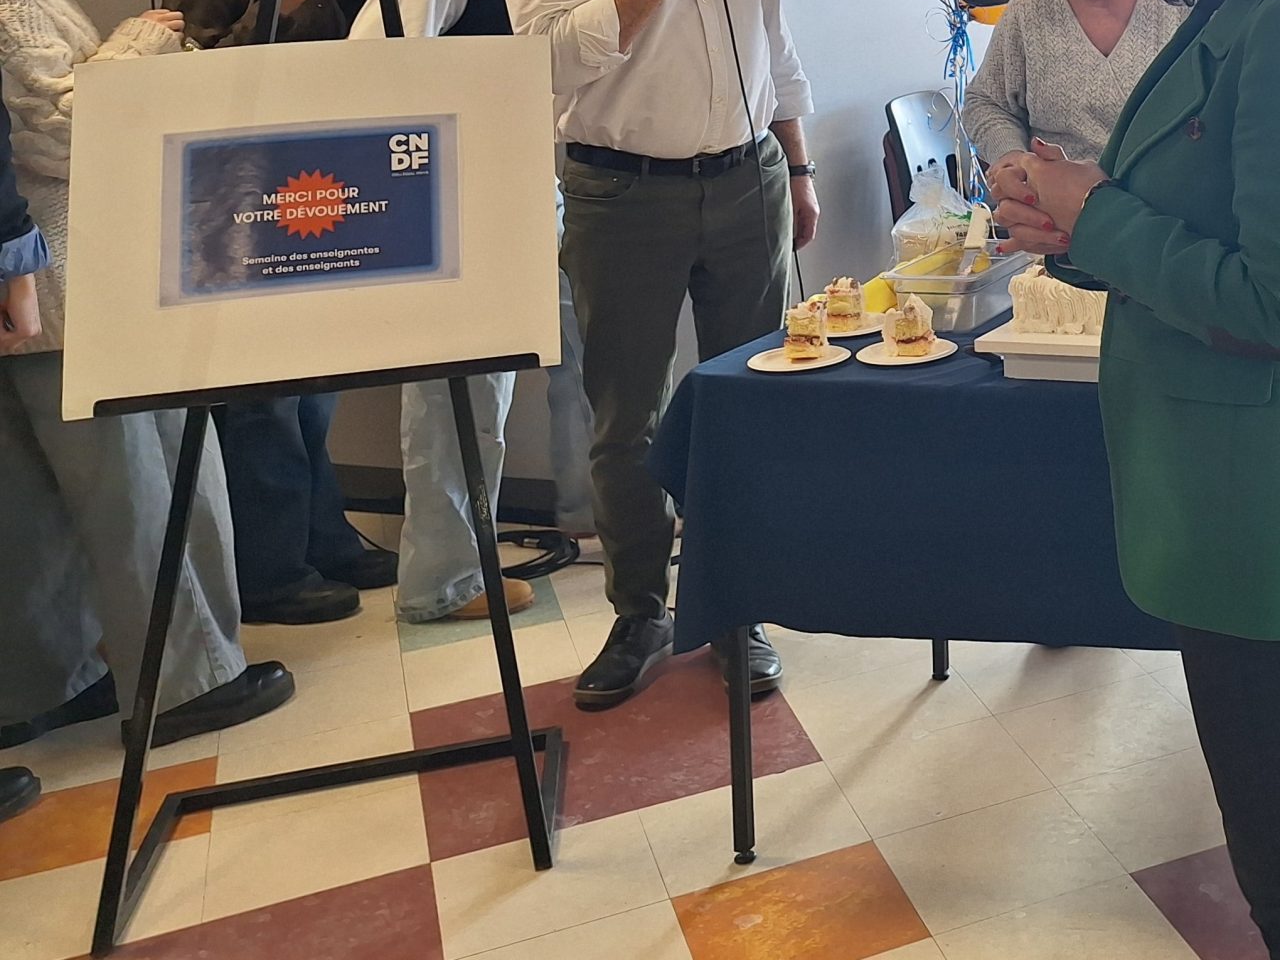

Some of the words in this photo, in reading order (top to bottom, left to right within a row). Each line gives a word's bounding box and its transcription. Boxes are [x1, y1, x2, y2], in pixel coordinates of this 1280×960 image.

[389, 133, 429, 152] CN
[391, 151, 429, 171] DF
[262, 191, 312, 205] MERCI
[316, 187, 359, 201] POUR
[233, 209, 282, 224] VOTRE
[286, 200, 389, 220] DÉVOUEMENT
[241, 254, 288, 266] Semaine
[289, 252, 308, 261] des
[310, 246, 380, 259] enseignantes
[262, 266, 273, 275] et
[275, 265, 294, 273] des
[296, 259, 360, 271] enseignants
